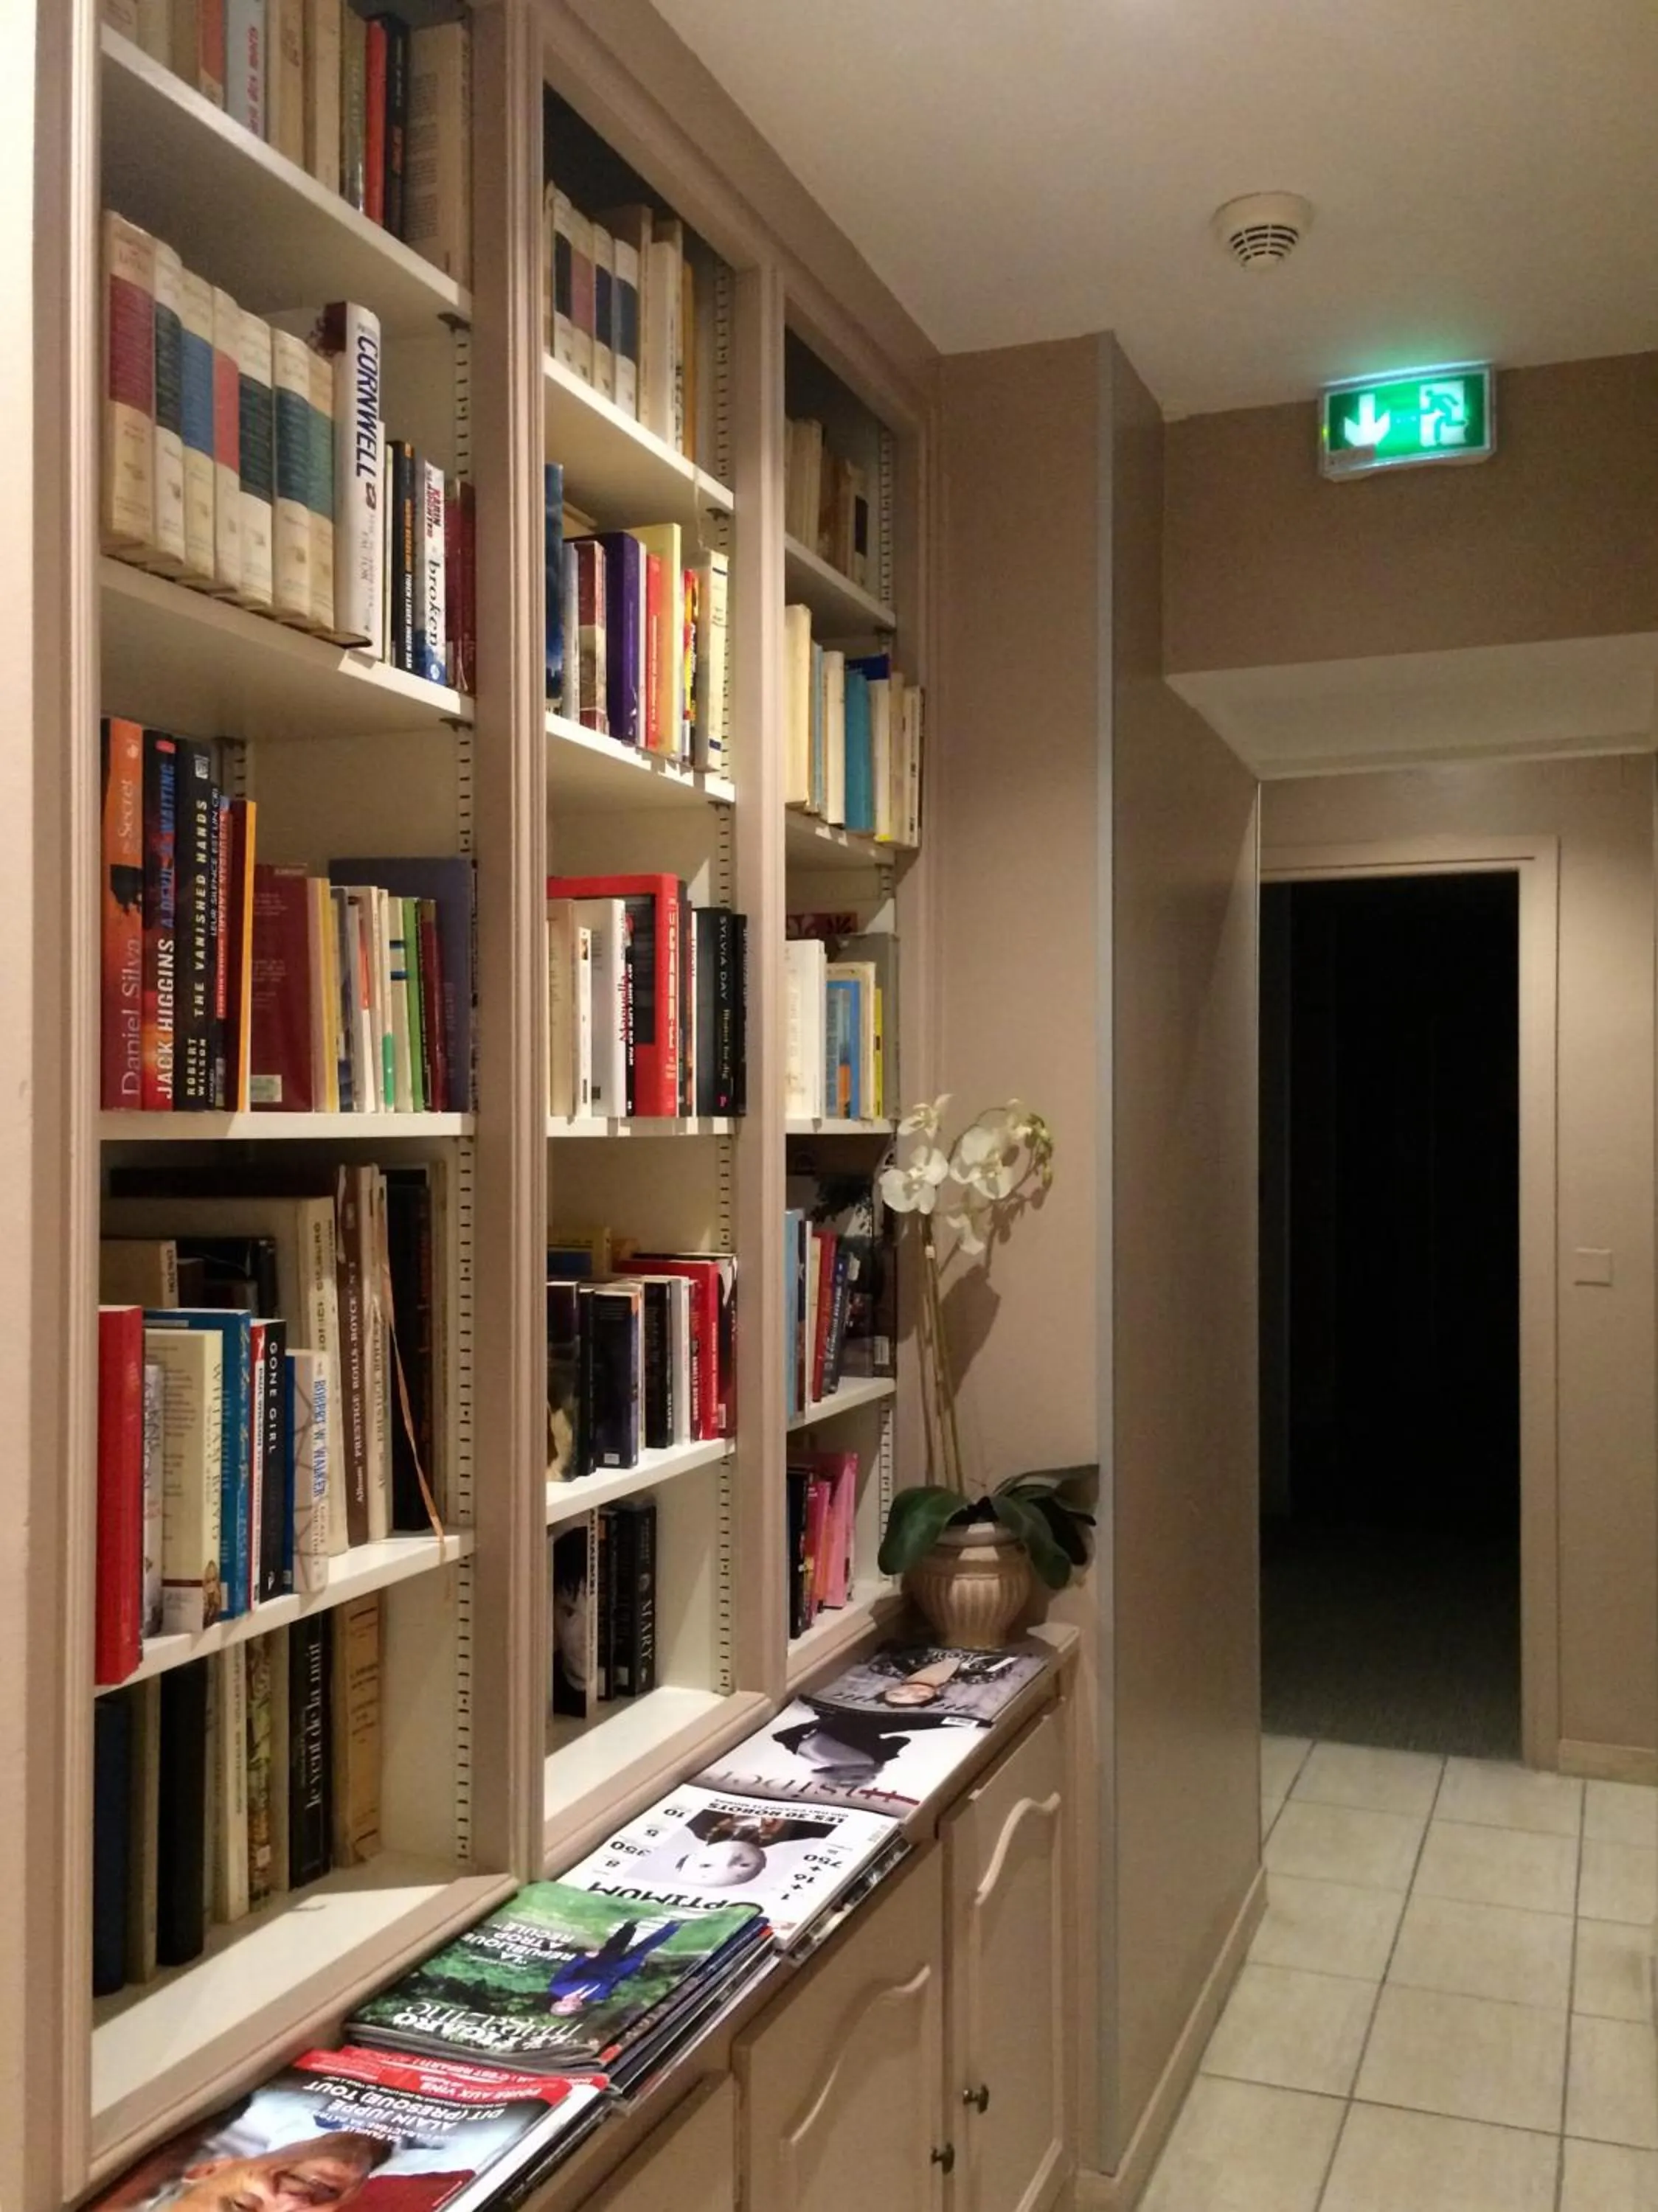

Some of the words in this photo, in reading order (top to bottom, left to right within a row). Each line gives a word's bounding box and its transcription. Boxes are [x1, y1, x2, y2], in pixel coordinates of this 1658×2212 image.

[355, 334, 379, 479] CORNWELL
[432, 488, 443, 526] KARIN
[427, 559, 442, 647] broken
[116, 778, 135, 841] Secret
[159, 763, 174, 835] WAITING
[194, 799, 207, 863] HANDS
[193, 873, 207, 970] VANISHED
[719, 916, 727, 966] SYLVIA
[120, 937, 141, 998] Silva
[156, 938, 174, 1032] HIGGINS
[193, 983, 207, 1018] THE
[120, 1008, 142, 1096] Daniel
[156, 1040, 174, 1100] JACK
[187, 1037, 197, 1097] ROBERT
[197, 1037, 207, 1097] WILSON
[268, 1341, 278, 1397] GONE
[212, 1363, 221, 1464] WILLIAM
[268, 1407, 277, 1454] GIRL
[355, 1466, 364, 1503] Album
[639, 1598, 653, 1660] MARY
[662, 1806, 687, 1819] 10
[706, 1802, 782, 1818] ROBOTS
[810, 1813, 846, 1824] LES
[608, 1840, 652, 1858] 350
[803, 1852, 844, 1868] 750
[792, 1873, 816, 1884] 16
[492, 1930, 544, 1948] TROP
[391, 2011, 516, 2053] FIGARO
[302, 2079, 355, 2101] TOUT
[359, 2092, 468, 2122] (PRESQUE)
[460, 2089, 490, 2101] AUX
[391, 2112, 457, 2132] ALAIN
[470, 2107, 505, 2122] DIT
